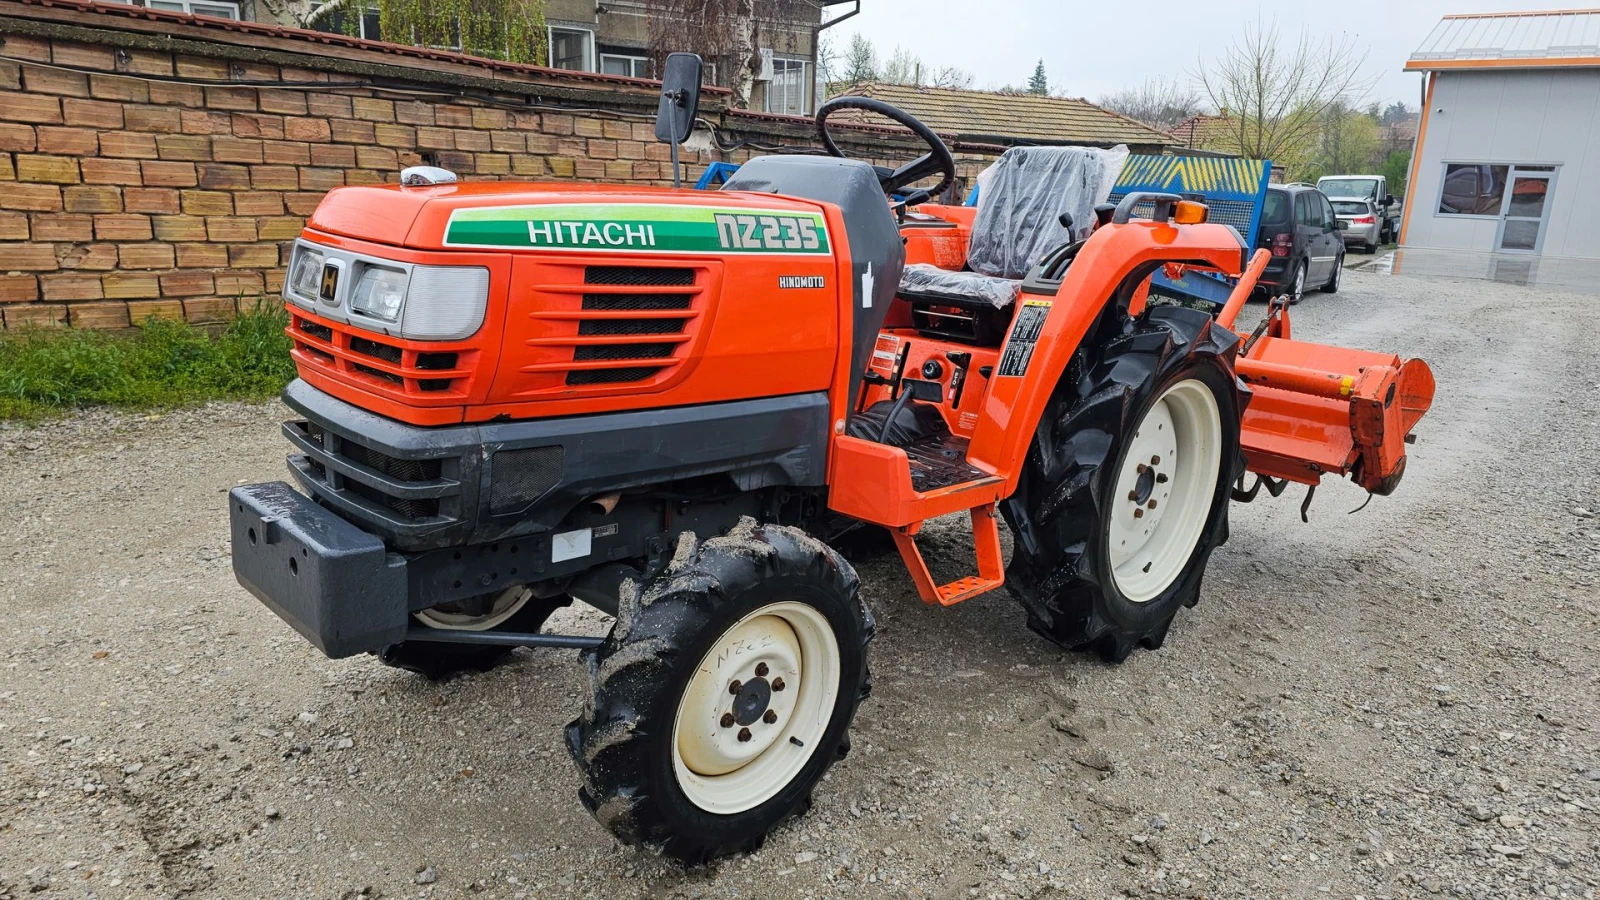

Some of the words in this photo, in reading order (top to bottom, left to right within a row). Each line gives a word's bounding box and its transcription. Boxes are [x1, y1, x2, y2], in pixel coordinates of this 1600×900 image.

[527, 220, 656, 246] HITACHI
[714, 213, 820, 249] NZ235
[779, 276, 825, 288] HINOMOTO
